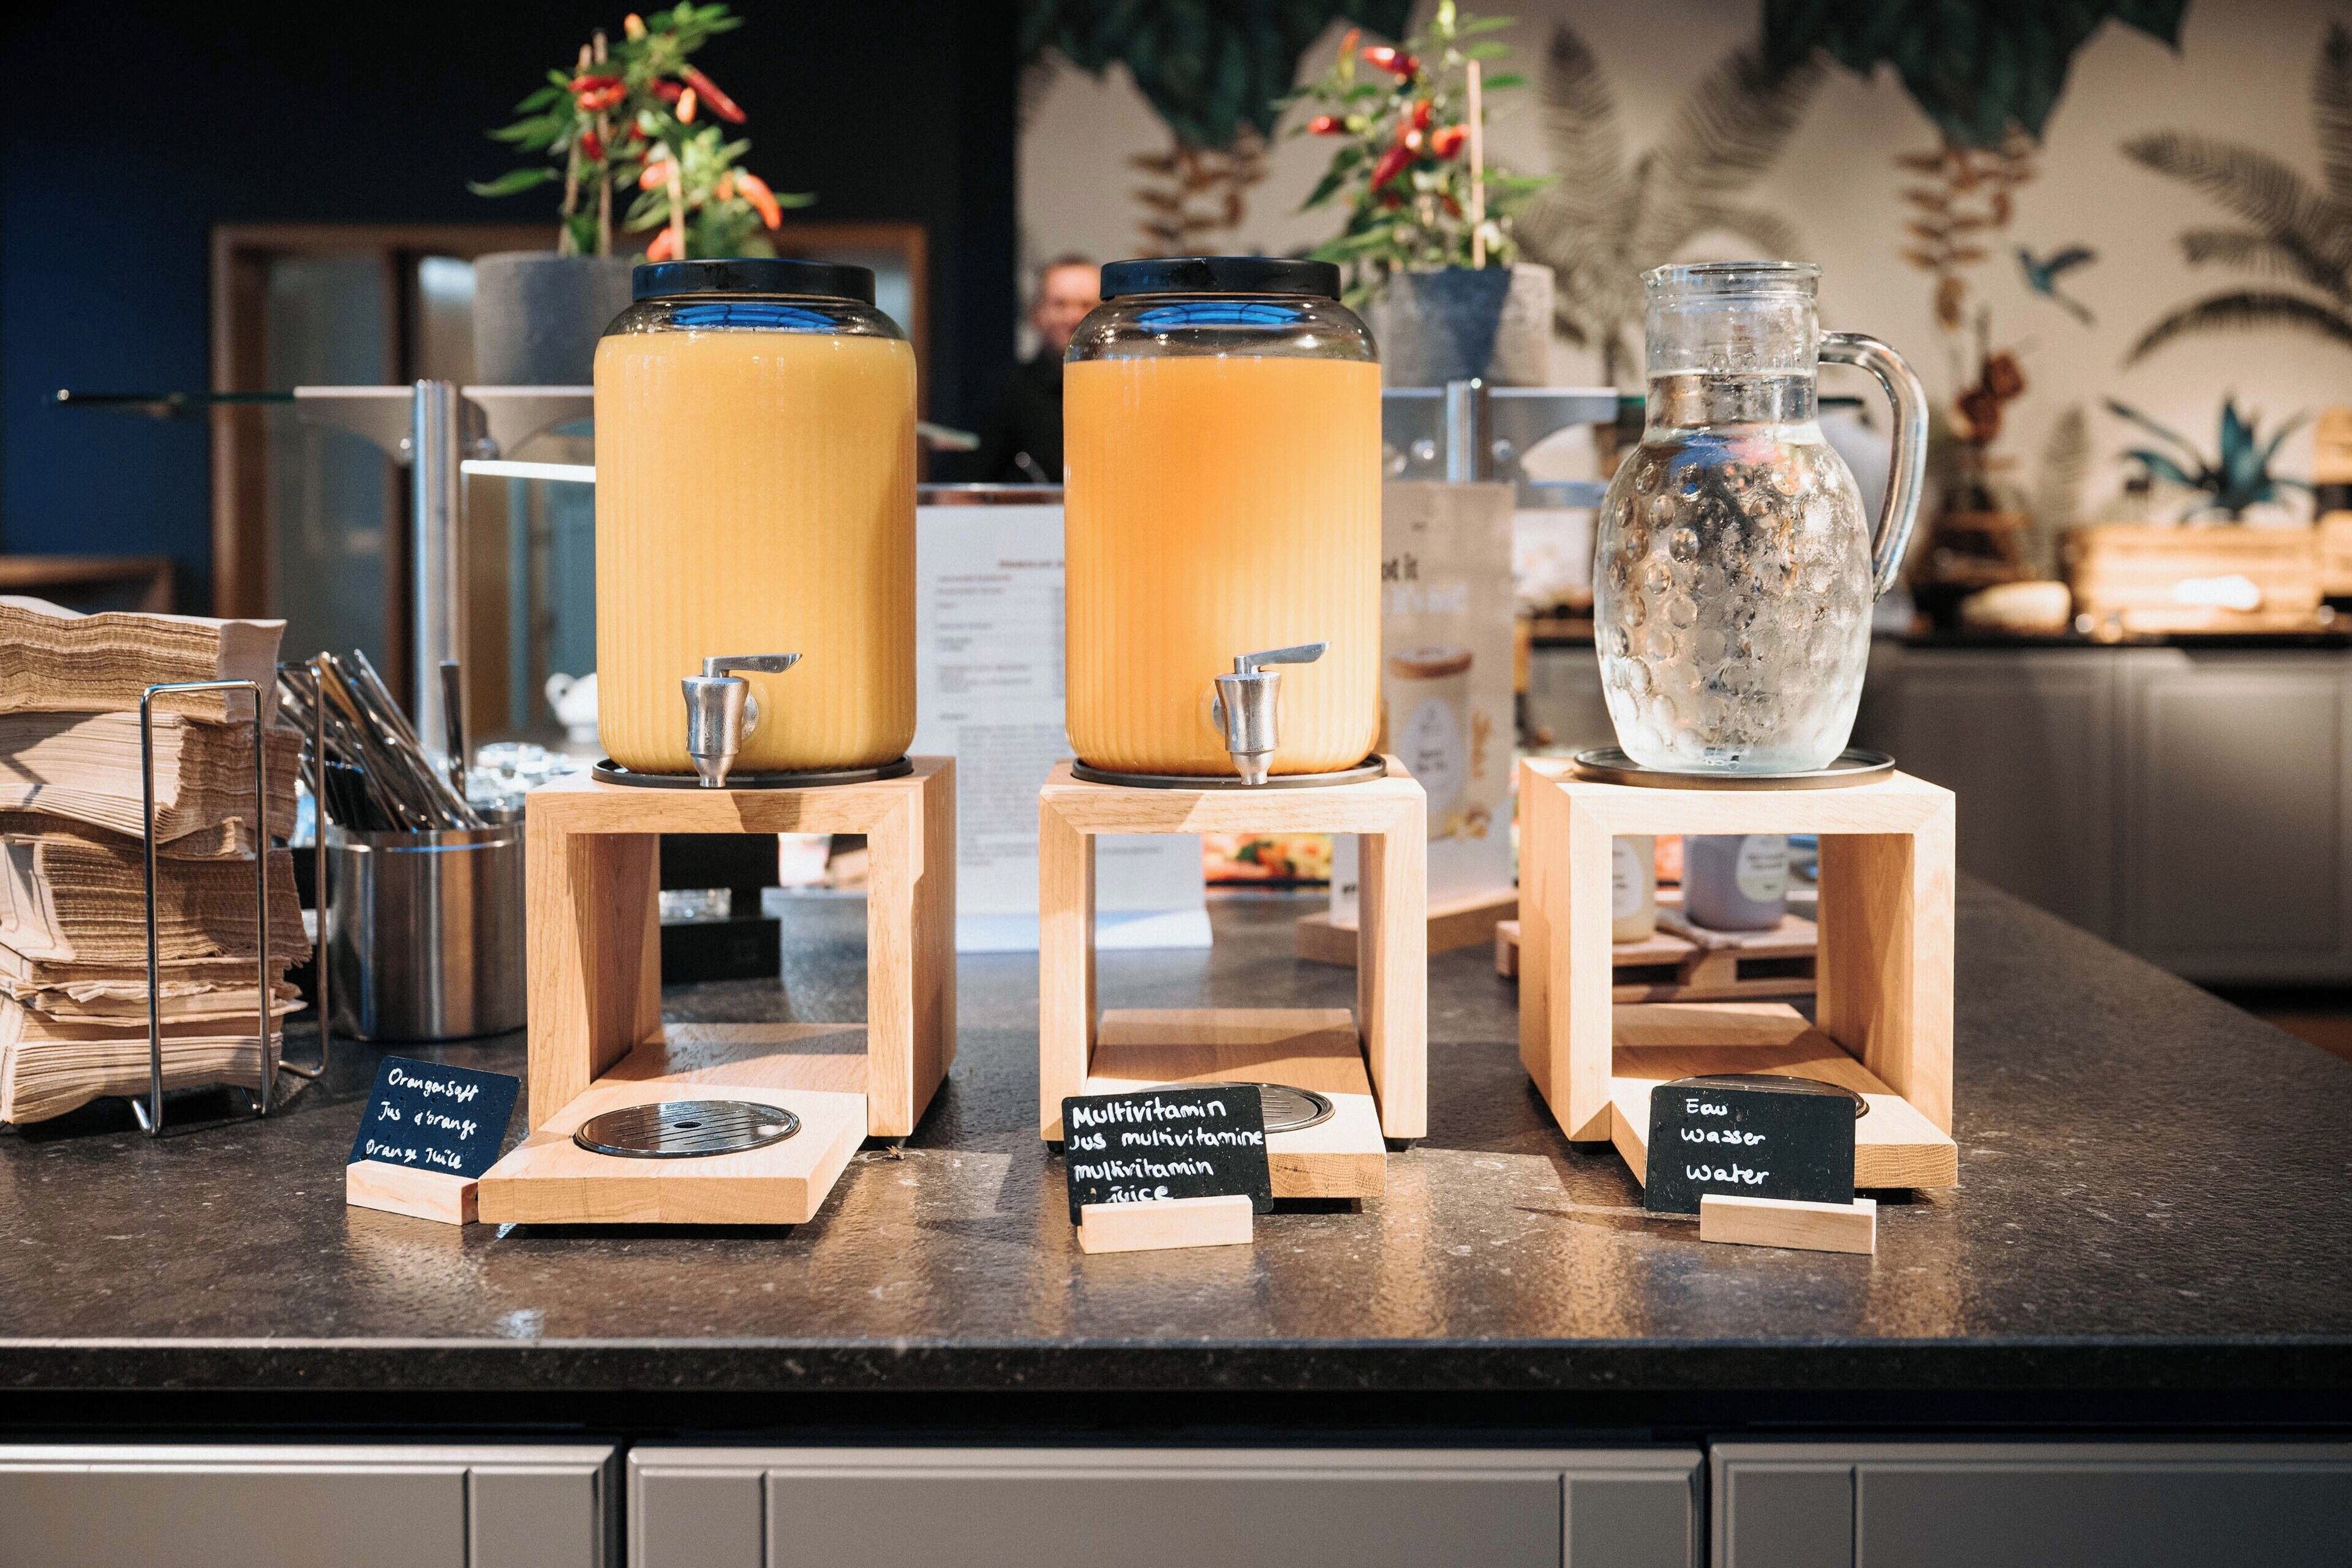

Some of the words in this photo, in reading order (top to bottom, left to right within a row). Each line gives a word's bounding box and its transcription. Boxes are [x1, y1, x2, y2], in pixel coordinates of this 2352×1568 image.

[1072, 1096, 1226, 1129] Multivitamin
[1685, 1098, 1728, 1116] Eau
[378, 1101, 401, 1121] Jus
[414, 1110, 477, 1140] d'orange
[1121, 1126, 1264, 1148] multivitamine
[1074, 1158, 1214, 1182] multivitamin
